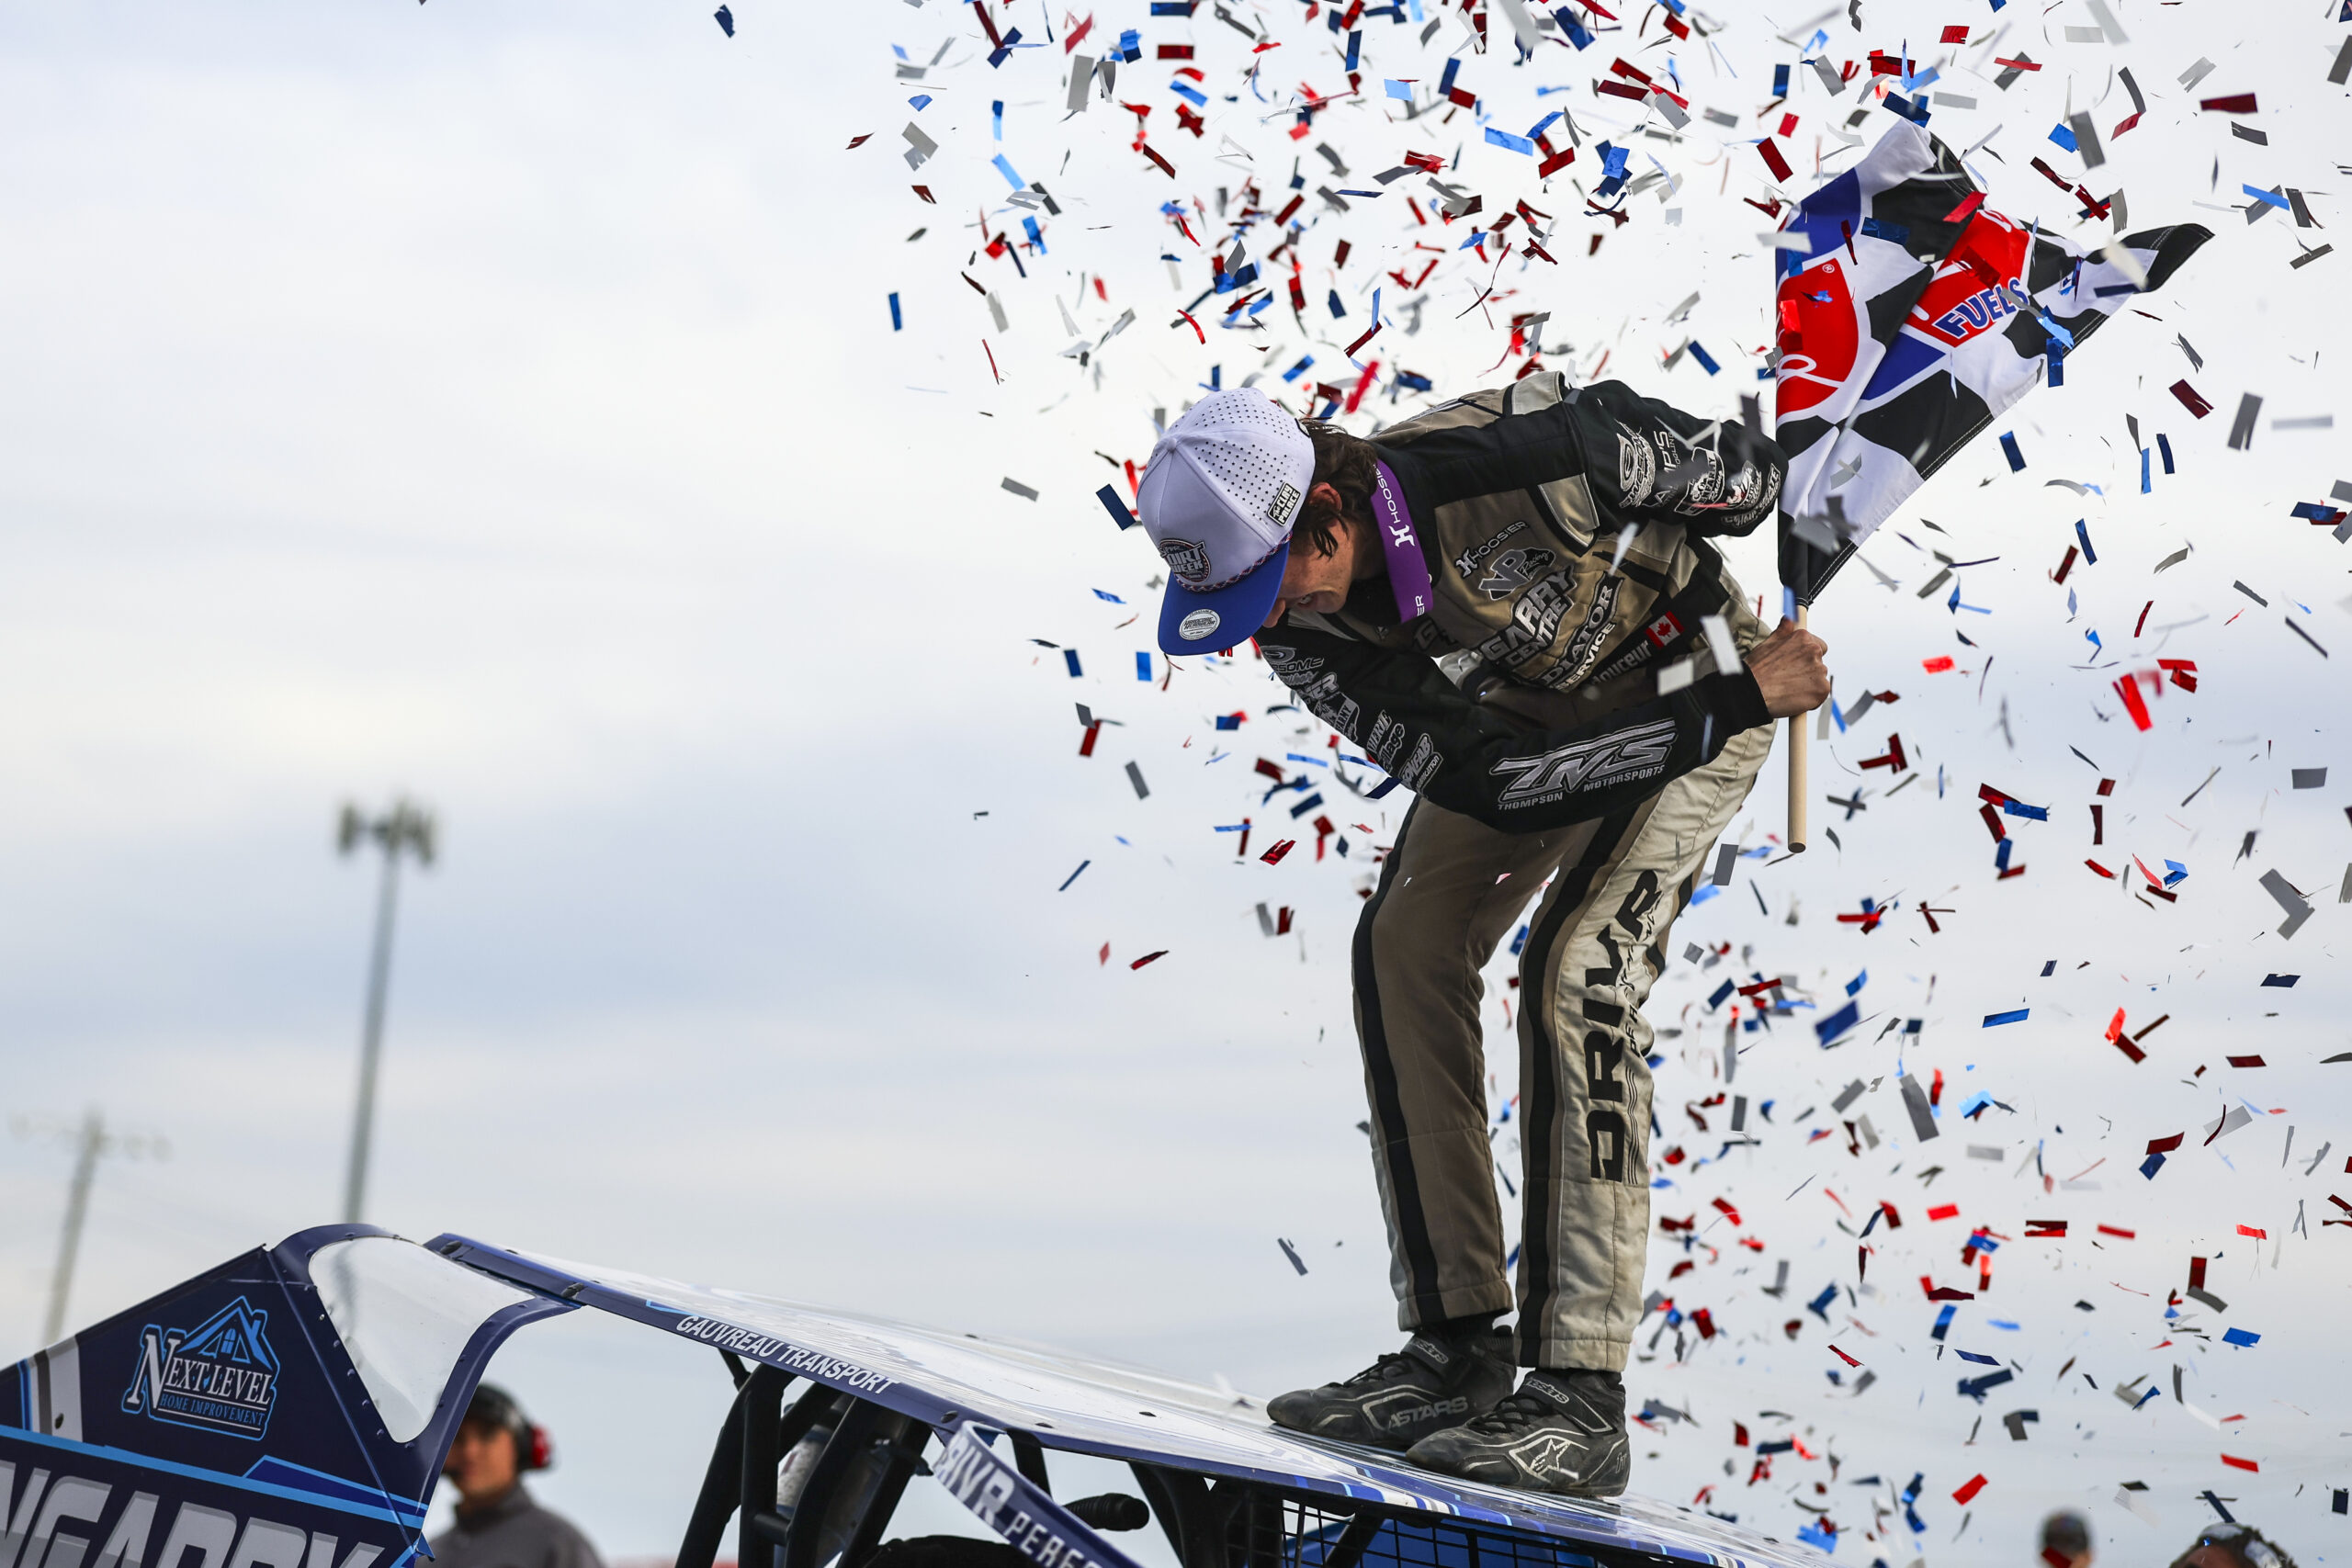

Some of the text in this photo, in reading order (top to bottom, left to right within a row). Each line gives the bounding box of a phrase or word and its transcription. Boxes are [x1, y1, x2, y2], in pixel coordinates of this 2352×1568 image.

[1931, 276, 2029, 341] FUELS
[1277, 490, 1301, 524] PALACE
[1167, 543, 1204, 565] DIRT
[1468, 520, 1527, 564] HOOSIER
[1477, 548, 1528, 602] VP
[1505, 598, 1567, 666] CENTRE
[1498, 764, 1664, 811] THOMPSON MOTORSPORTS
[127, 1334, 273, 1409] NEXT LEVEL
[675, 1314, 900, 1394] GAUVREAU TRANSPORT
[160, 1393, 266, 1427] HOME IMPROVEMENT
[1388, 1394, 1469, 1431] ASTARS
